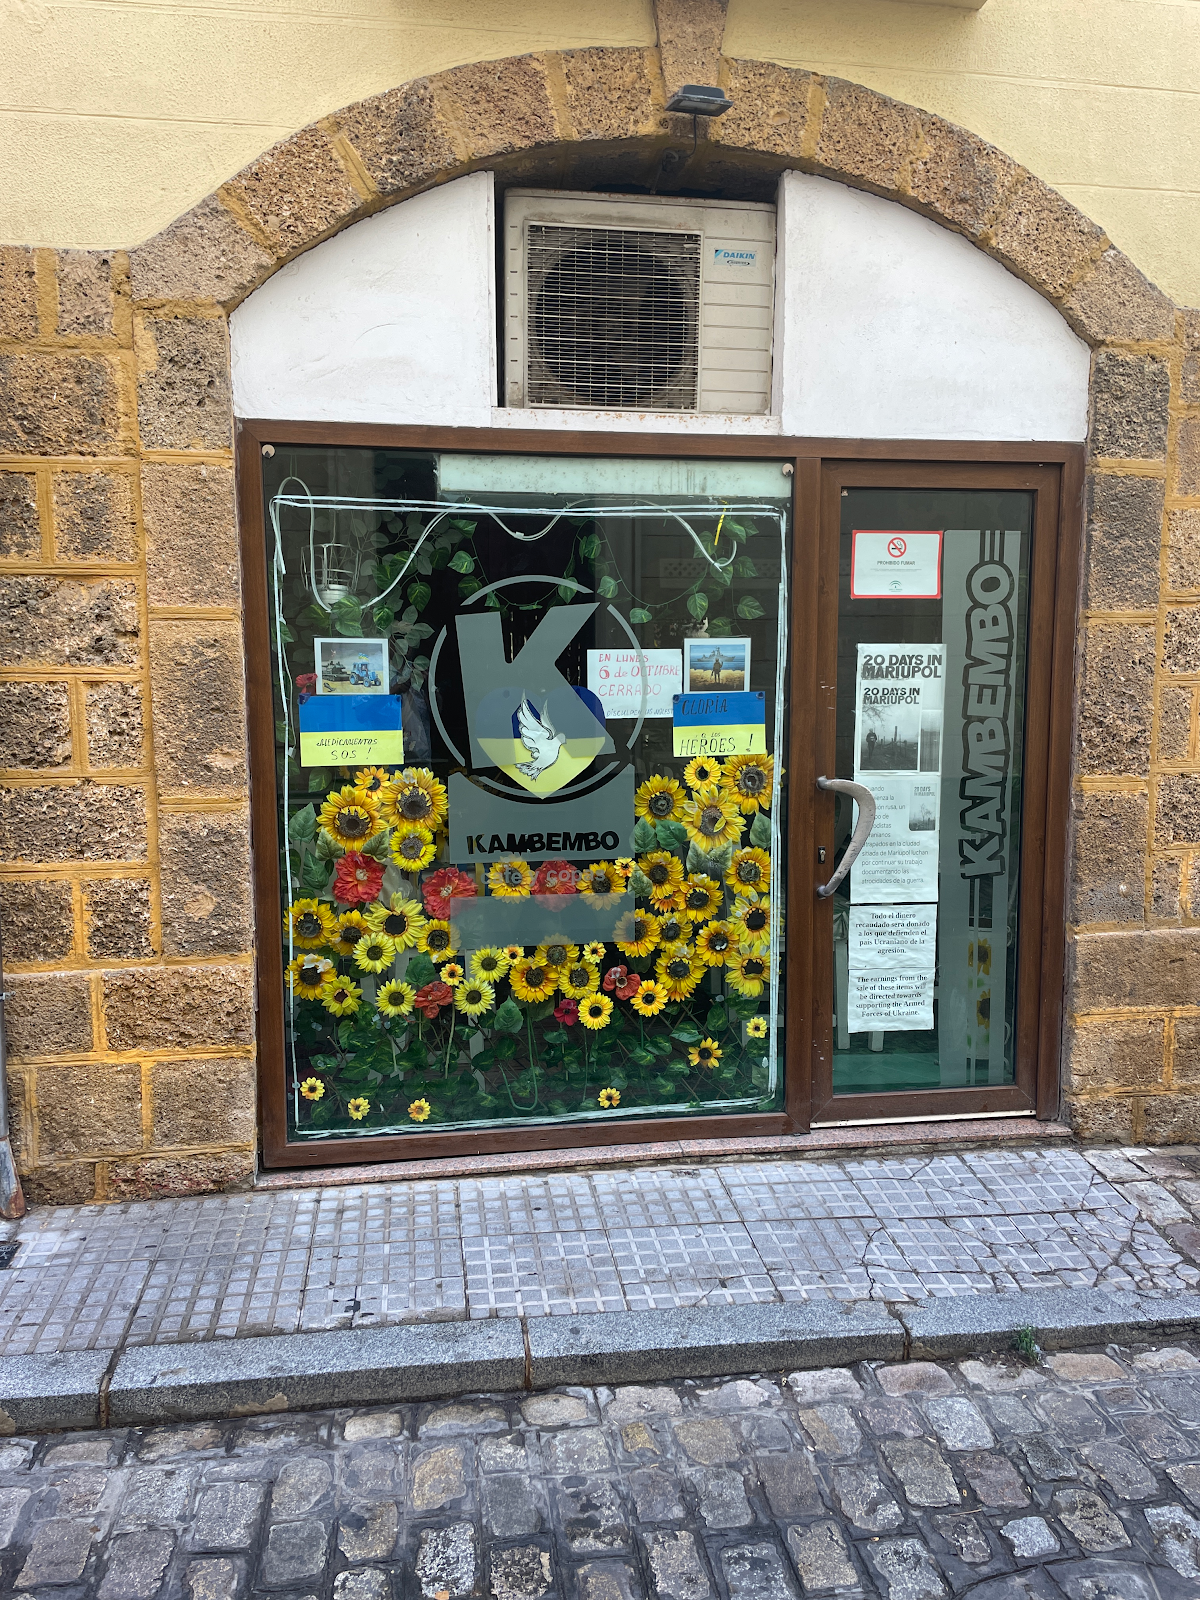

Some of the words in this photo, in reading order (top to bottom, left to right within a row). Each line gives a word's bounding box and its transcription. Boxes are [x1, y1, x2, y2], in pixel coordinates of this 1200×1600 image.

[599, 654, 611, 662] EN
[616, 654, 649, 662] LUNES
[864, 654, 885, 665] 20
[889, 655, 924, 665] DAYS
[927, 655, 942, 665] IN
[599, 666, 610, 679] 6
[614, 666, 628, 678] de
[630, 664, 680, 677] OCTUBRE
[862, 666, 941, 678] MARIUPOL
[598, 684, 662, 696] CERRADO
[863, 696, 919, 704] MARIUPOL
[960, 561, 1013, 879] KAMBEMBO
[331, 750, 356, 760] SOS
[466, 831, 619, 854] KAMBEMBO
[529, 872, 539, 887] y
[546, 869, 606, 885] copas
